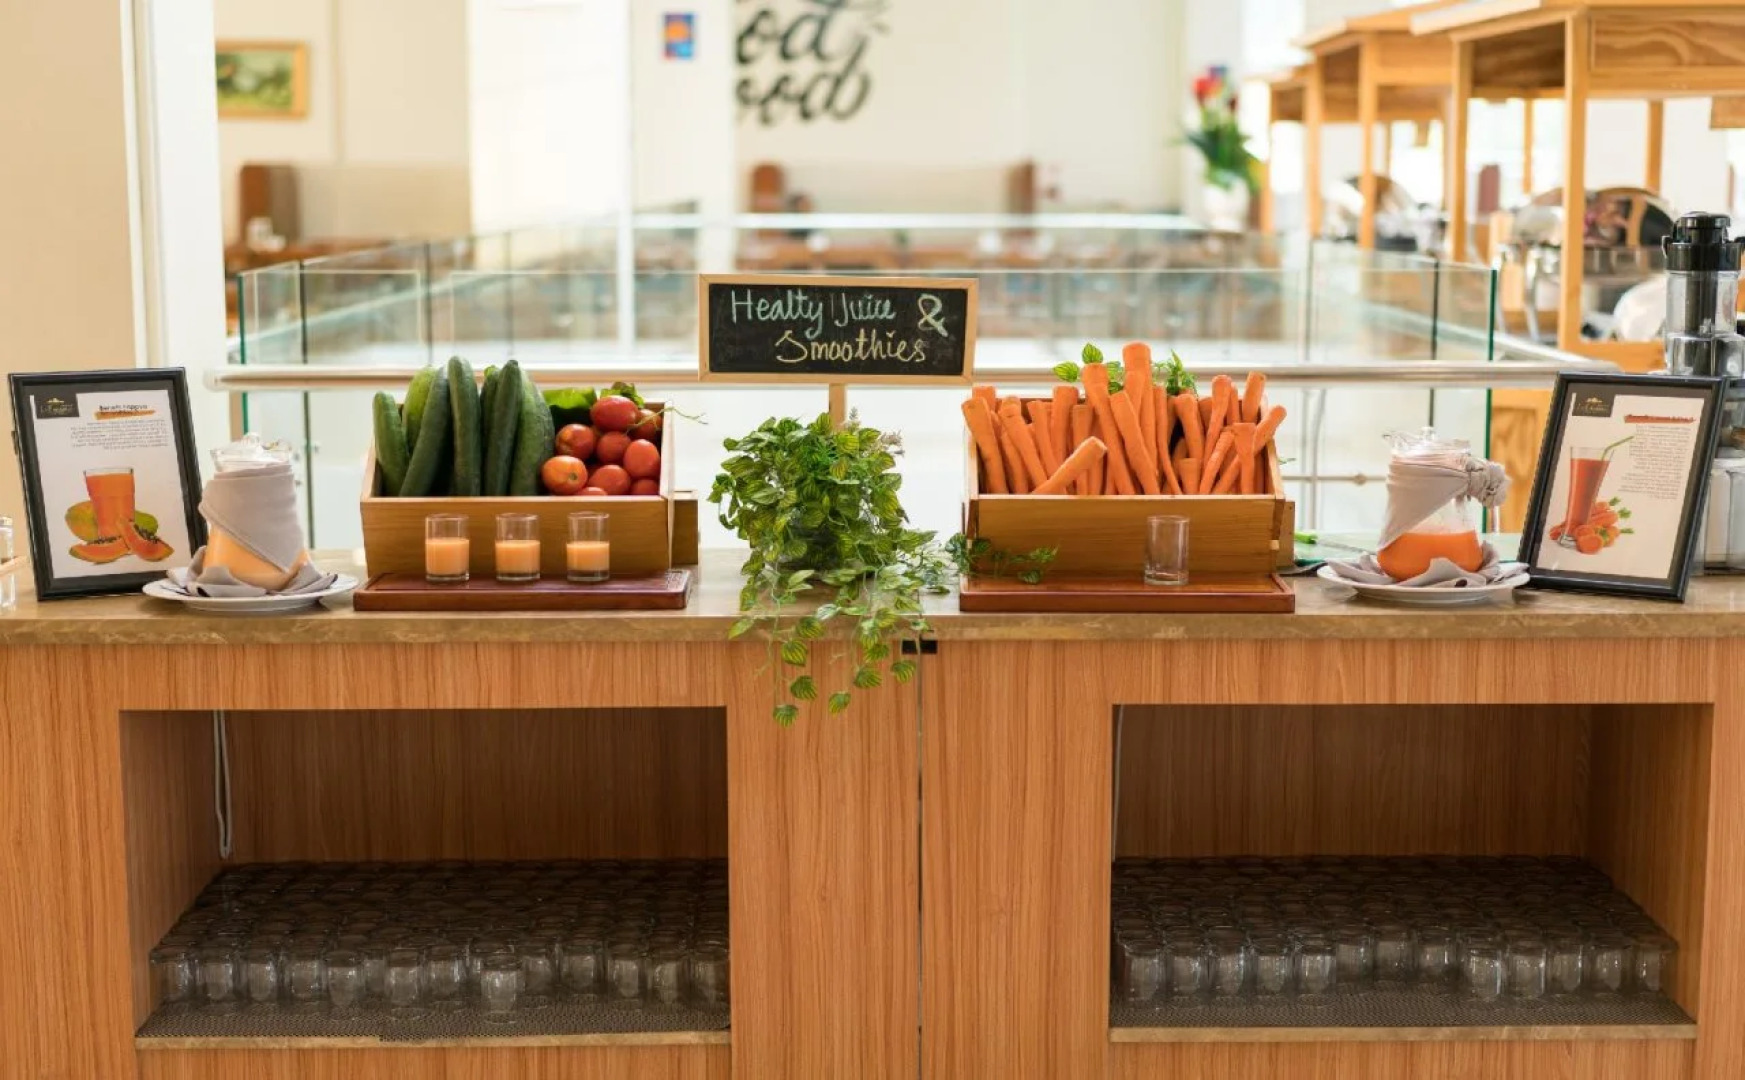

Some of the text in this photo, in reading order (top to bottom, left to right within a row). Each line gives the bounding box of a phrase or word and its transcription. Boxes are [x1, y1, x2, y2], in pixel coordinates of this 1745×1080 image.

[730, 289, 949, 340] Healty Juice &
[775, 328, 928, 363] Smoothies
